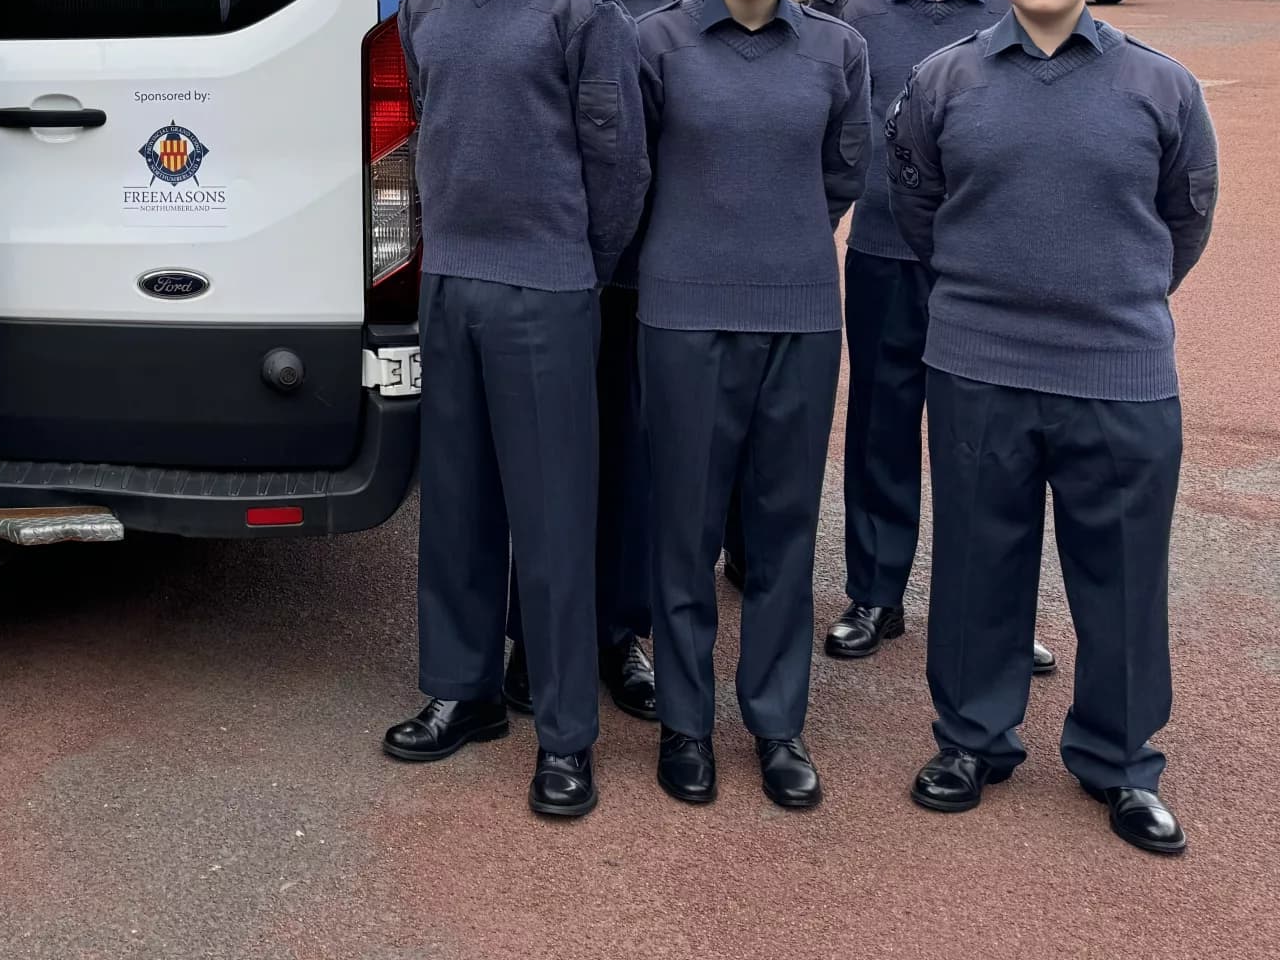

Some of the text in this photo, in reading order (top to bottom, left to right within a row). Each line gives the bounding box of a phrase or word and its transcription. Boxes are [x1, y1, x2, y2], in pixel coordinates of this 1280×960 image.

[134, 89, 211, 104] Sponsored by:
[124, 190, 226, 203] FREEMASONS
[153, 276, 193, 292] Ford
